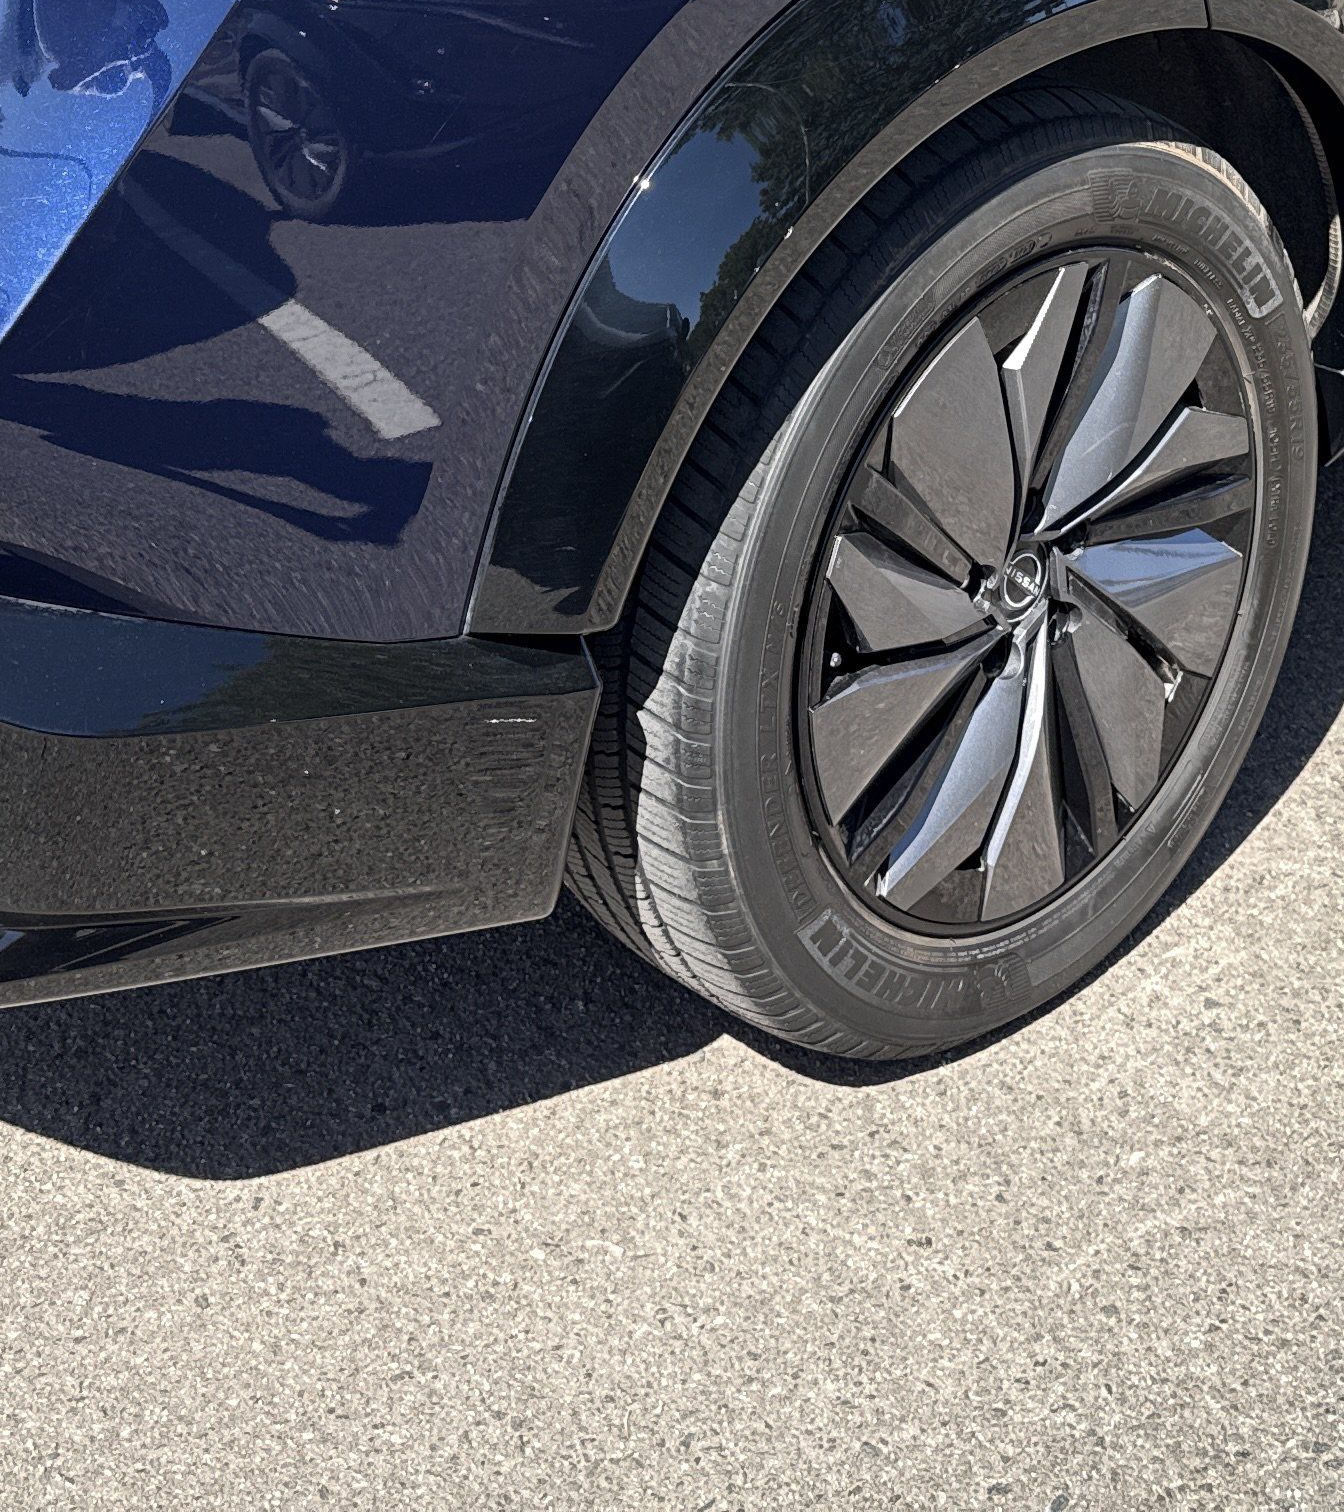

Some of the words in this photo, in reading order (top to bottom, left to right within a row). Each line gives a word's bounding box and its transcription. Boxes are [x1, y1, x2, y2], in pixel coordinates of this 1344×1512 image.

[1144, 186, 1278, 312] MICHELIN
[1006, 565, 1039, 597] NISSAN
[808, 914, 970, 1012] MICHELIN
